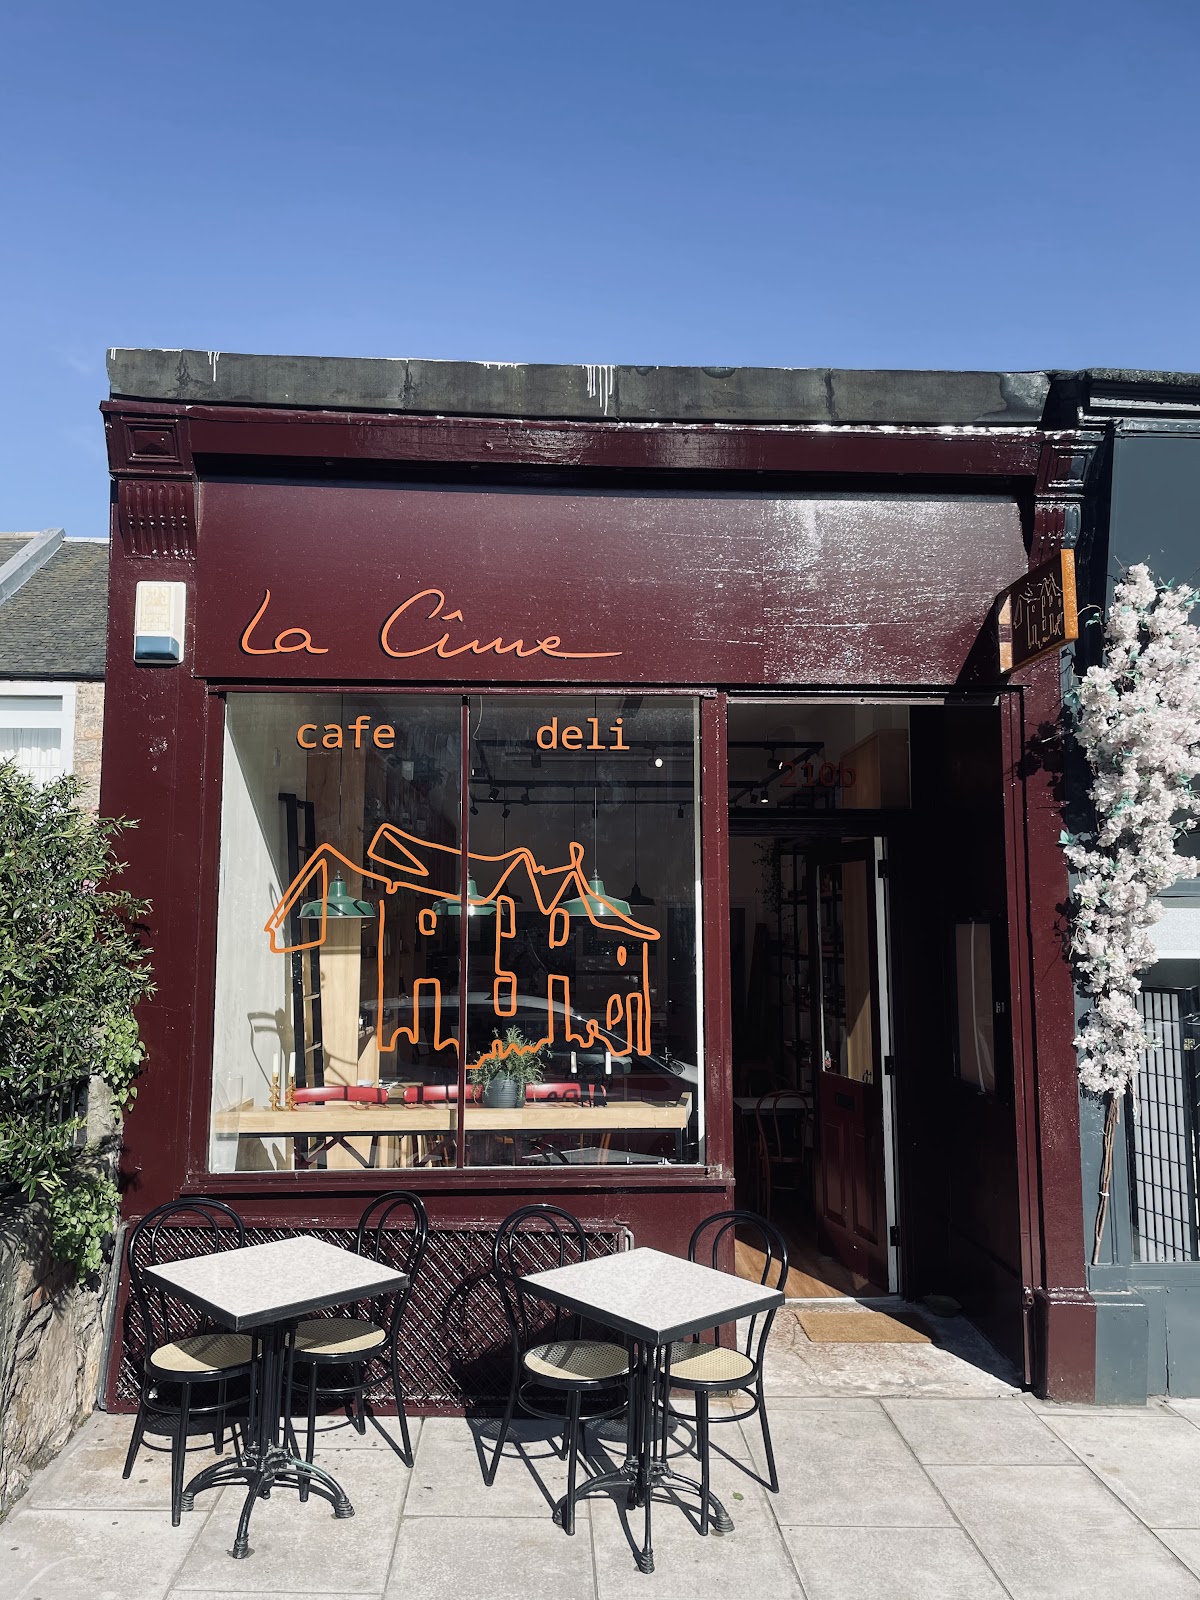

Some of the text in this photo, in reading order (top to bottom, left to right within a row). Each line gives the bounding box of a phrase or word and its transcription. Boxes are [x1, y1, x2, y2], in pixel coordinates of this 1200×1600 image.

[241, 589, 329, 655] La
[296, 715, 630, 750] cafe deli
[781, 761, 857, 788] 210b
